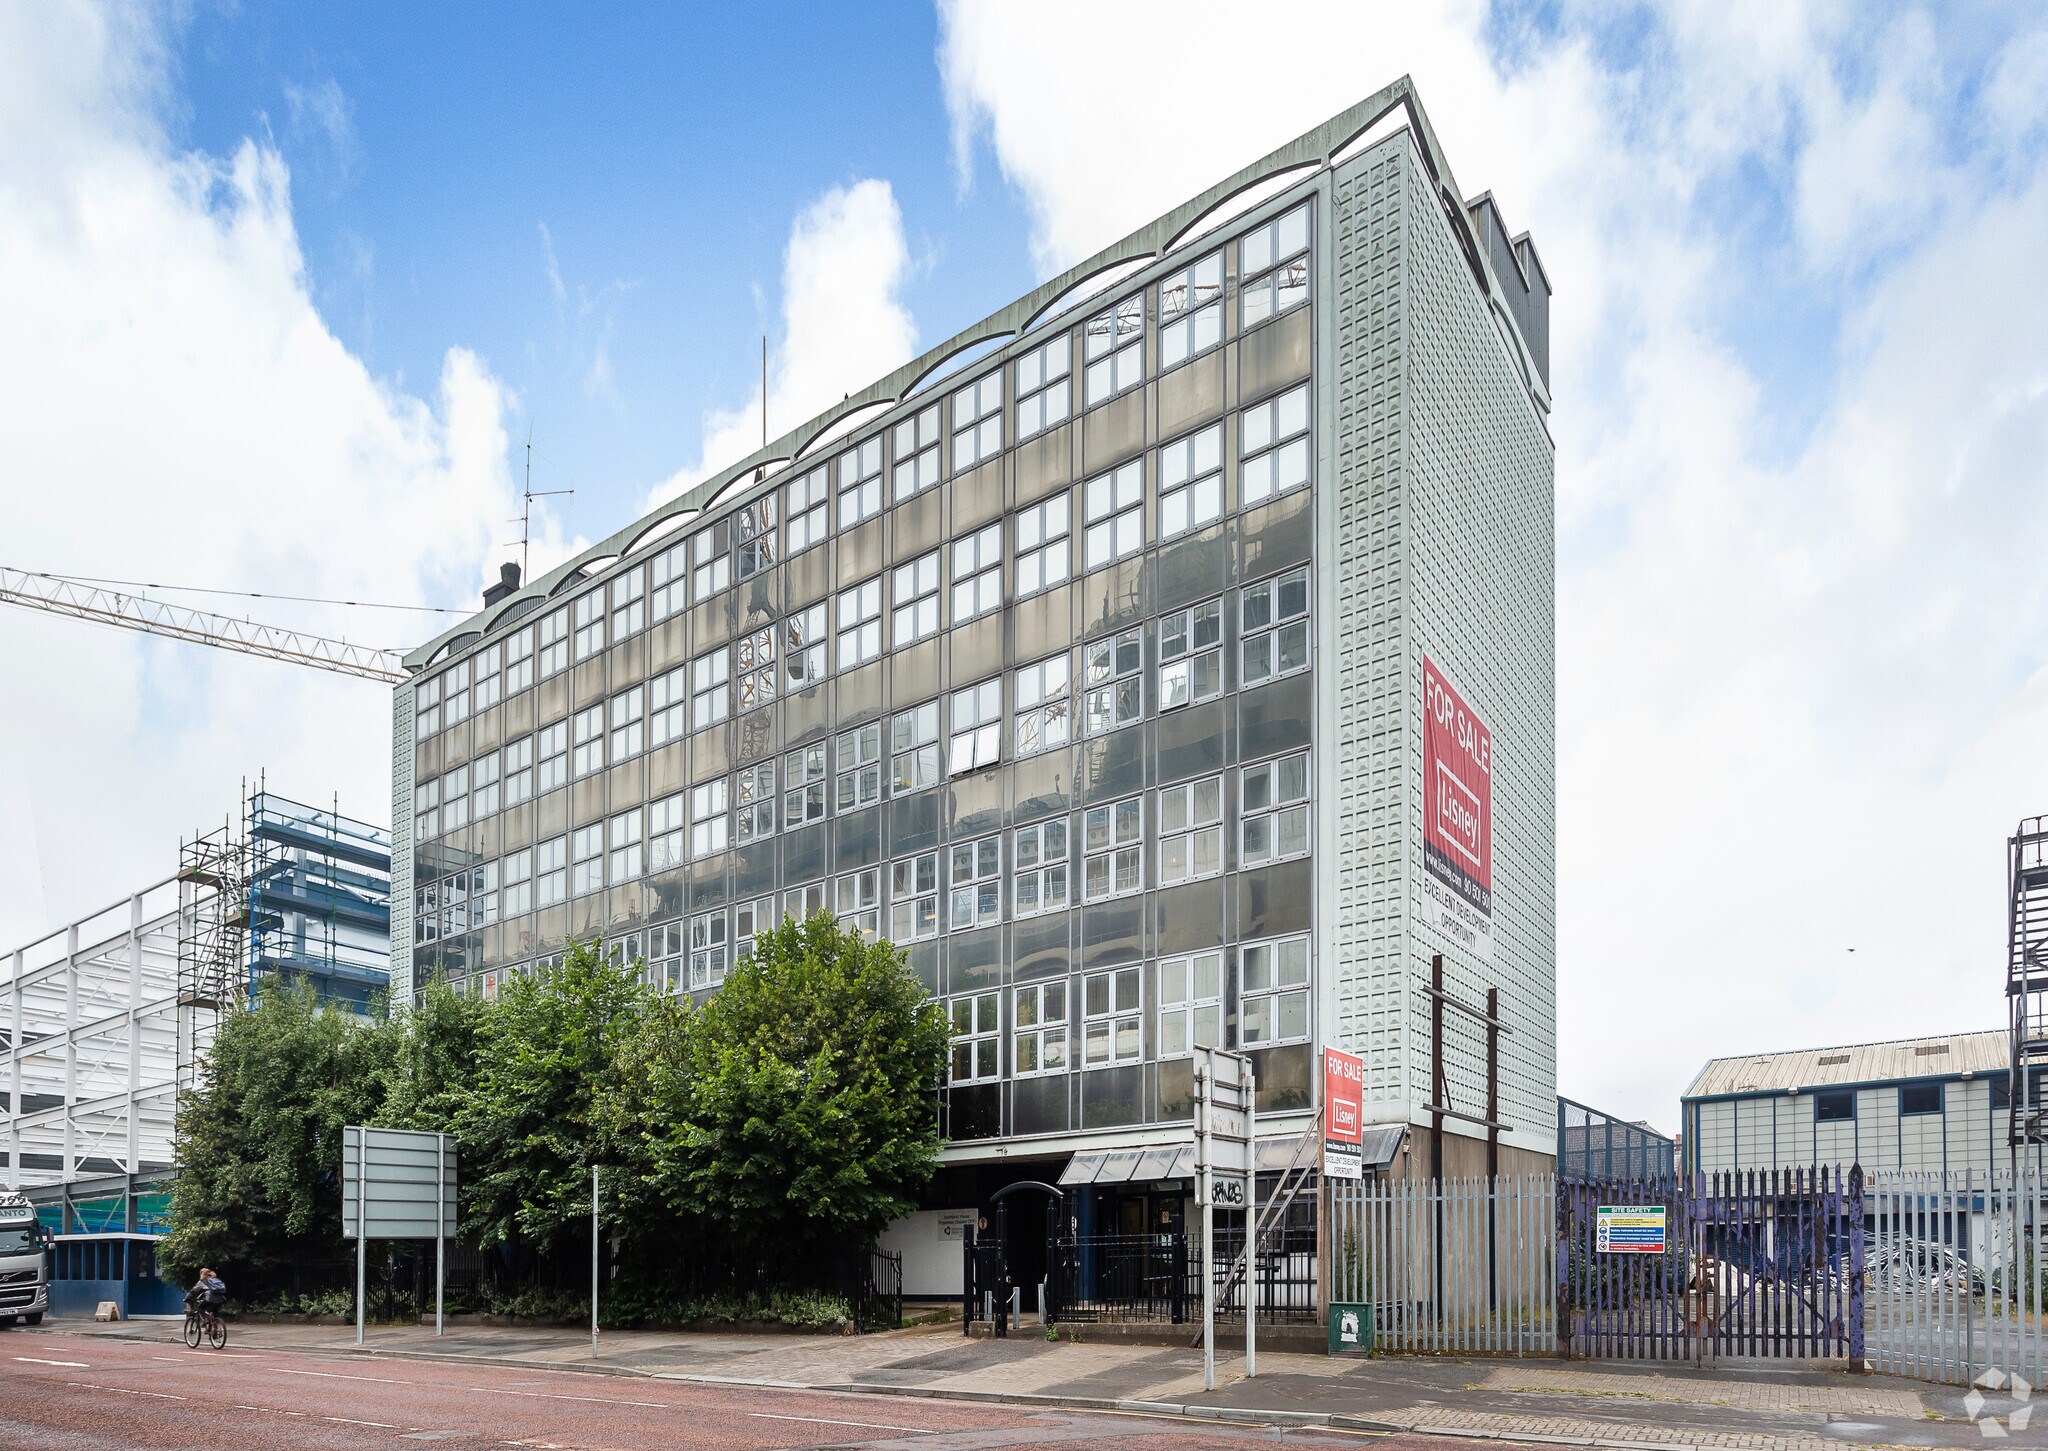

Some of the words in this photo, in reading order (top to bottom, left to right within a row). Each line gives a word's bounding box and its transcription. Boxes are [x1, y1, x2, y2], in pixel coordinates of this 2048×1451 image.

[1426, 670, 1455, 738] FOR
[1457, 709, 1489, 775] SALE
[1442, 779, 1477, 849] Lisney
[1424, 877, 1456, 913] EXCELLENT
[1456, 901, 1491, 938] DEVELOPMENT
[1441, 912, 1477, 948] OPPORTUNITY
[1328, 1056, 1343, 1077] FOR
[1344, 1061, 1361, 1082] SALE
[1335, 1106, 1355, 1129] Lisney
